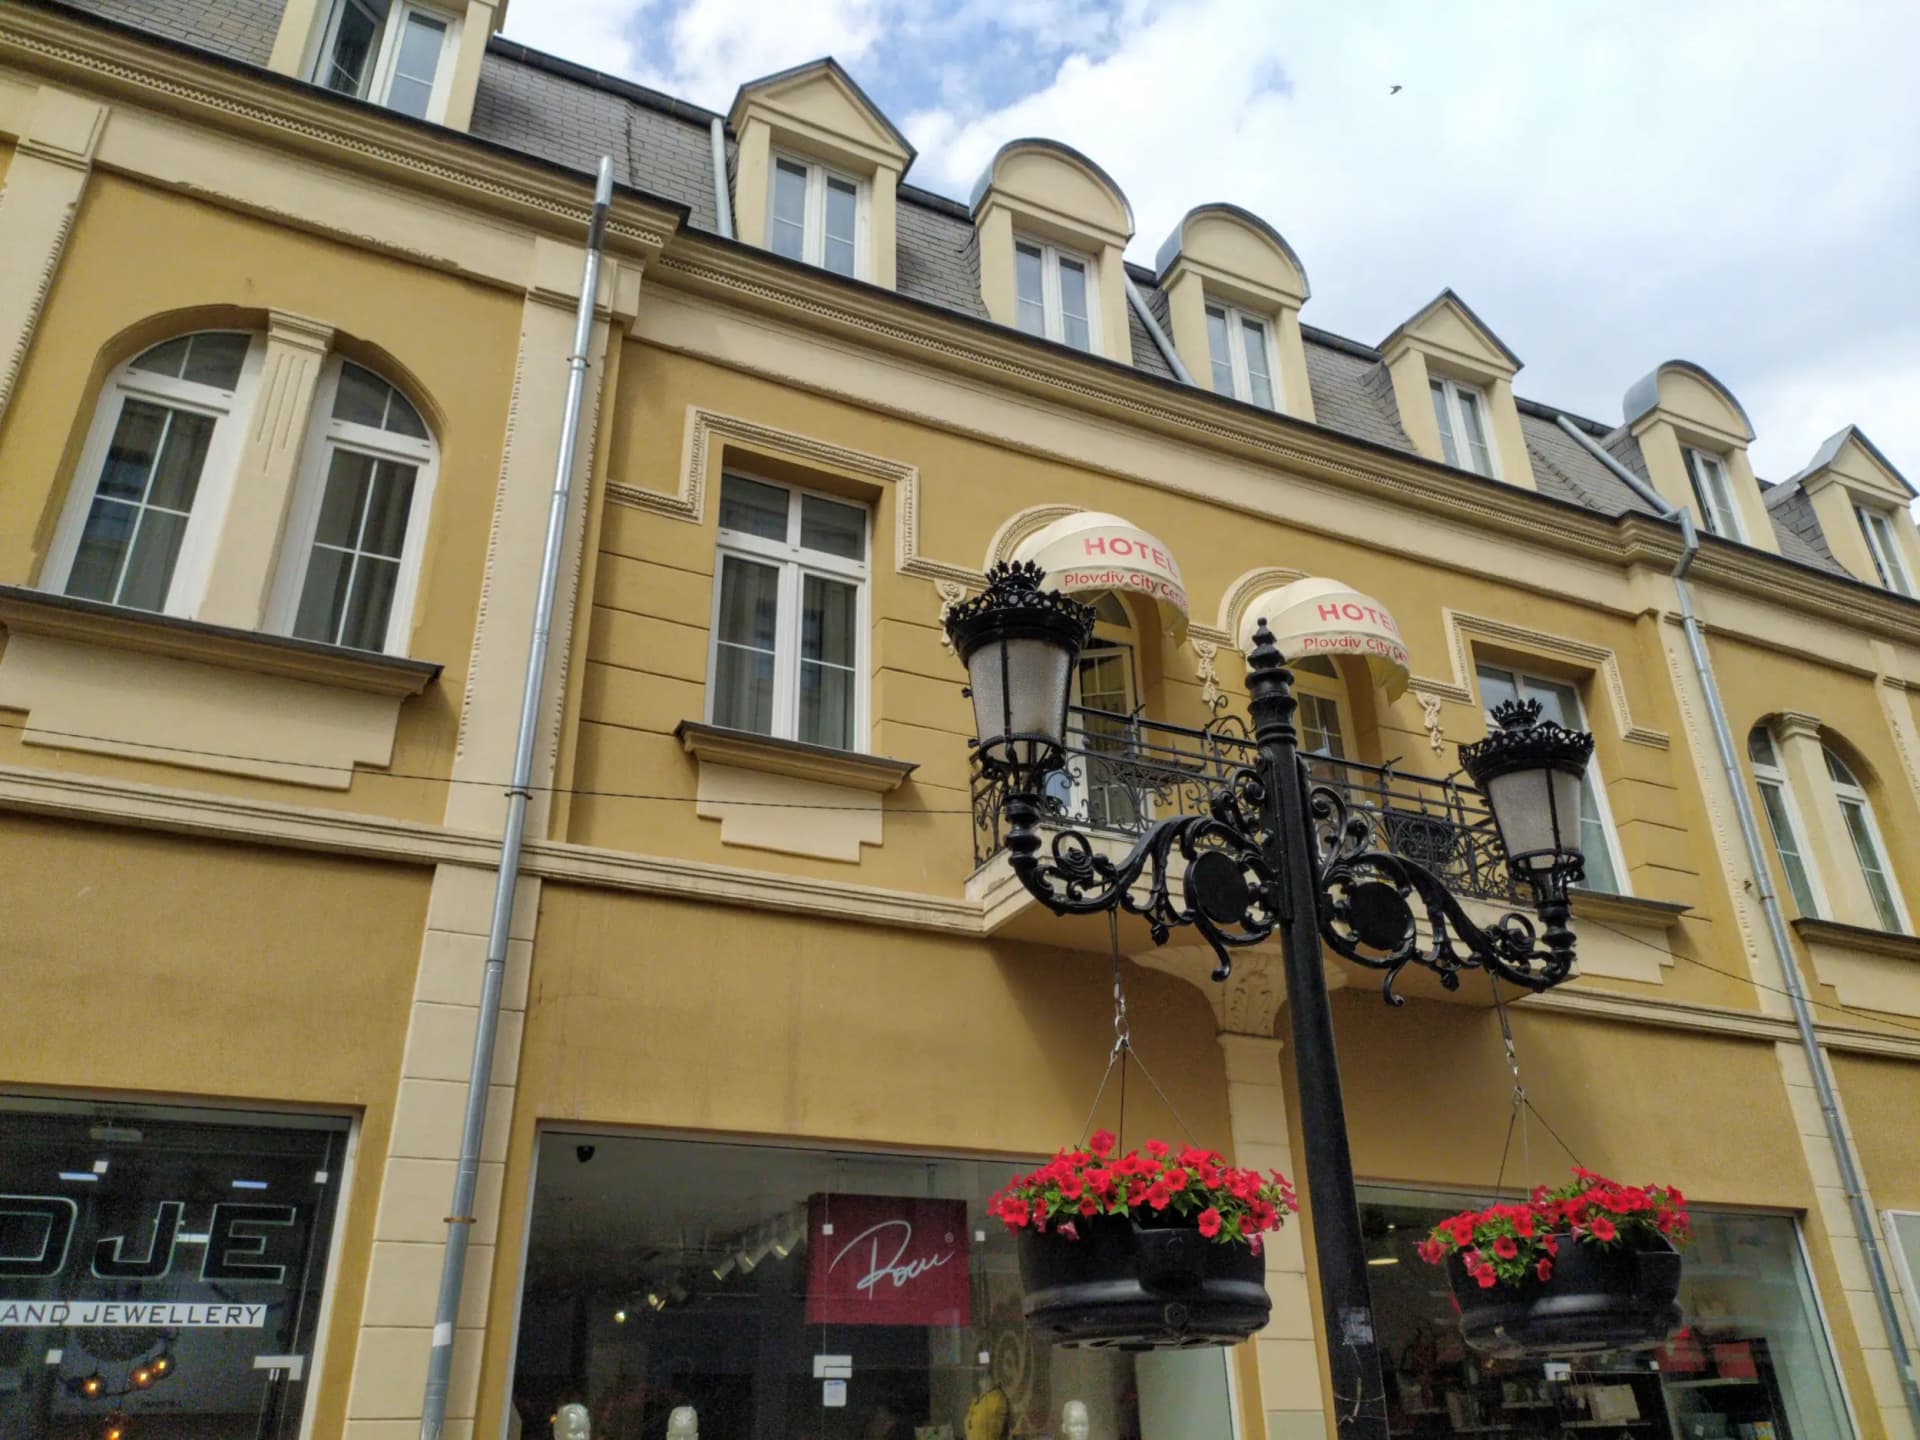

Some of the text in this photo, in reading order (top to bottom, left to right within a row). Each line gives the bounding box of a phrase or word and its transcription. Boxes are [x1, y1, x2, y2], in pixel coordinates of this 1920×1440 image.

[1084, 537, 1178, 579] HOTEL
[1064, 571, 1125, 586] Plovdiv
[1130, 574, 1158, 593] City
[1303, 636, 1361, 650] Plovdiv
[1366, 638, 1390, 657] City
[0, 1303, 262, 1325] AND JEWELLERY
